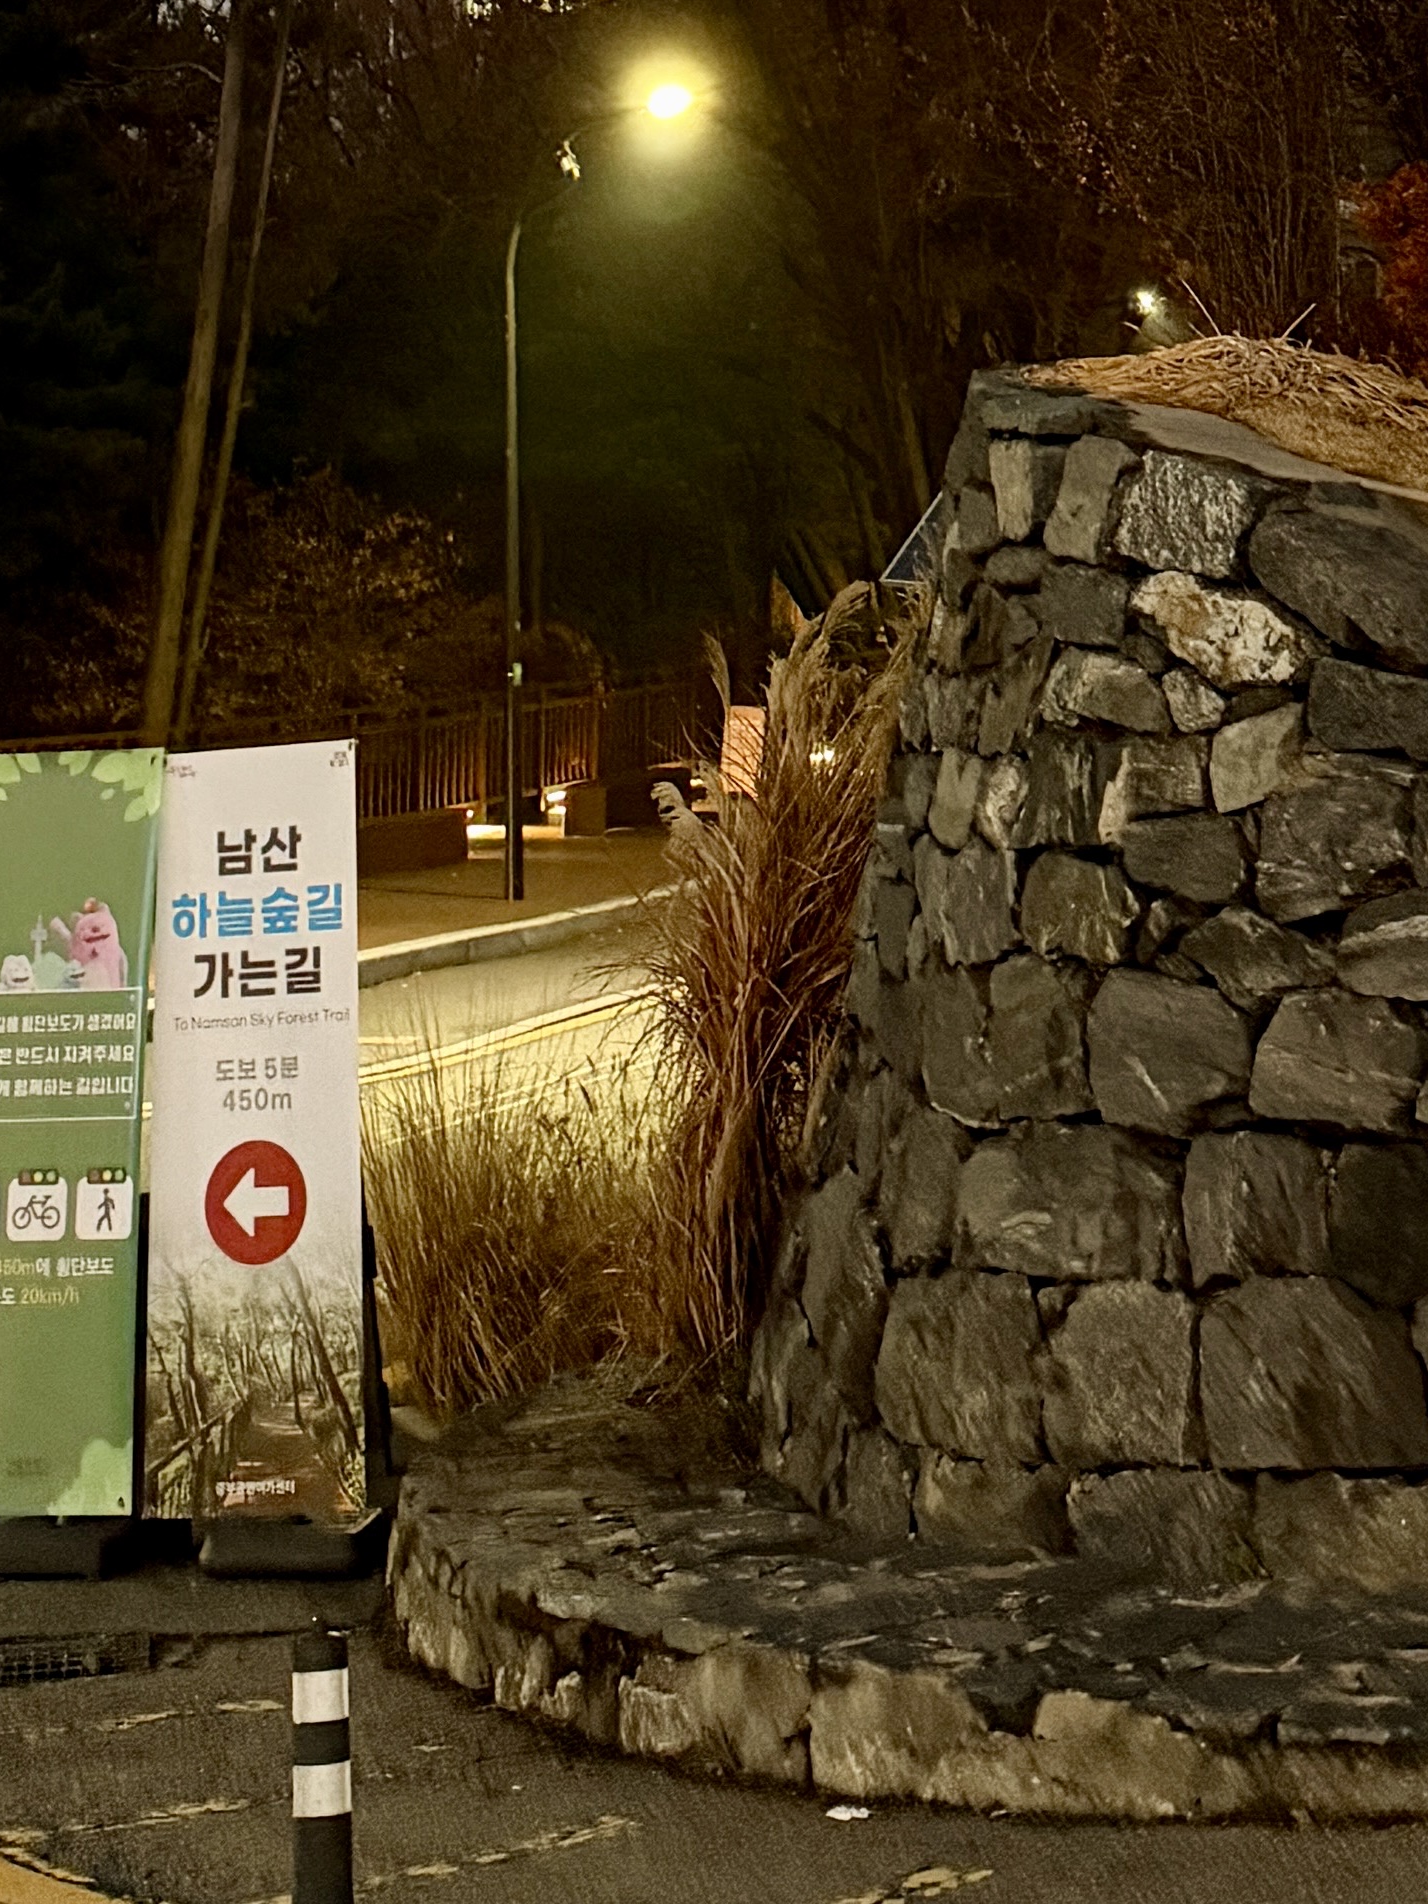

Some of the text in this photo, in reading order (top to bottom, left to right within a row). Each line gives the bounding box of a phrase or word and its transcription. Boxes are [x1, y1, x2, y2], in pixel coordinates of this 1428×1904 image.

[216, 825, 302, 876] 남산
[172, 883, 343, 938] 하늘숲길
[193, 946, 322, 998] 가는길
[173, 1007, 351, 1031] To Namsan Sky Forest Trail
[15, 1045, 60, 1065] 반드시
[62, 1044, 135, 1065] 지켜주세요
[215, 1055, 300, 1082] 도보 5분
[13, 1077, 74, 1097] 함께하는
[75, 1075, 134, 1096] 길입니다
[222, 1088, 292, 1113] 450m
[19, 1287, 81, 1306] 20km/h
